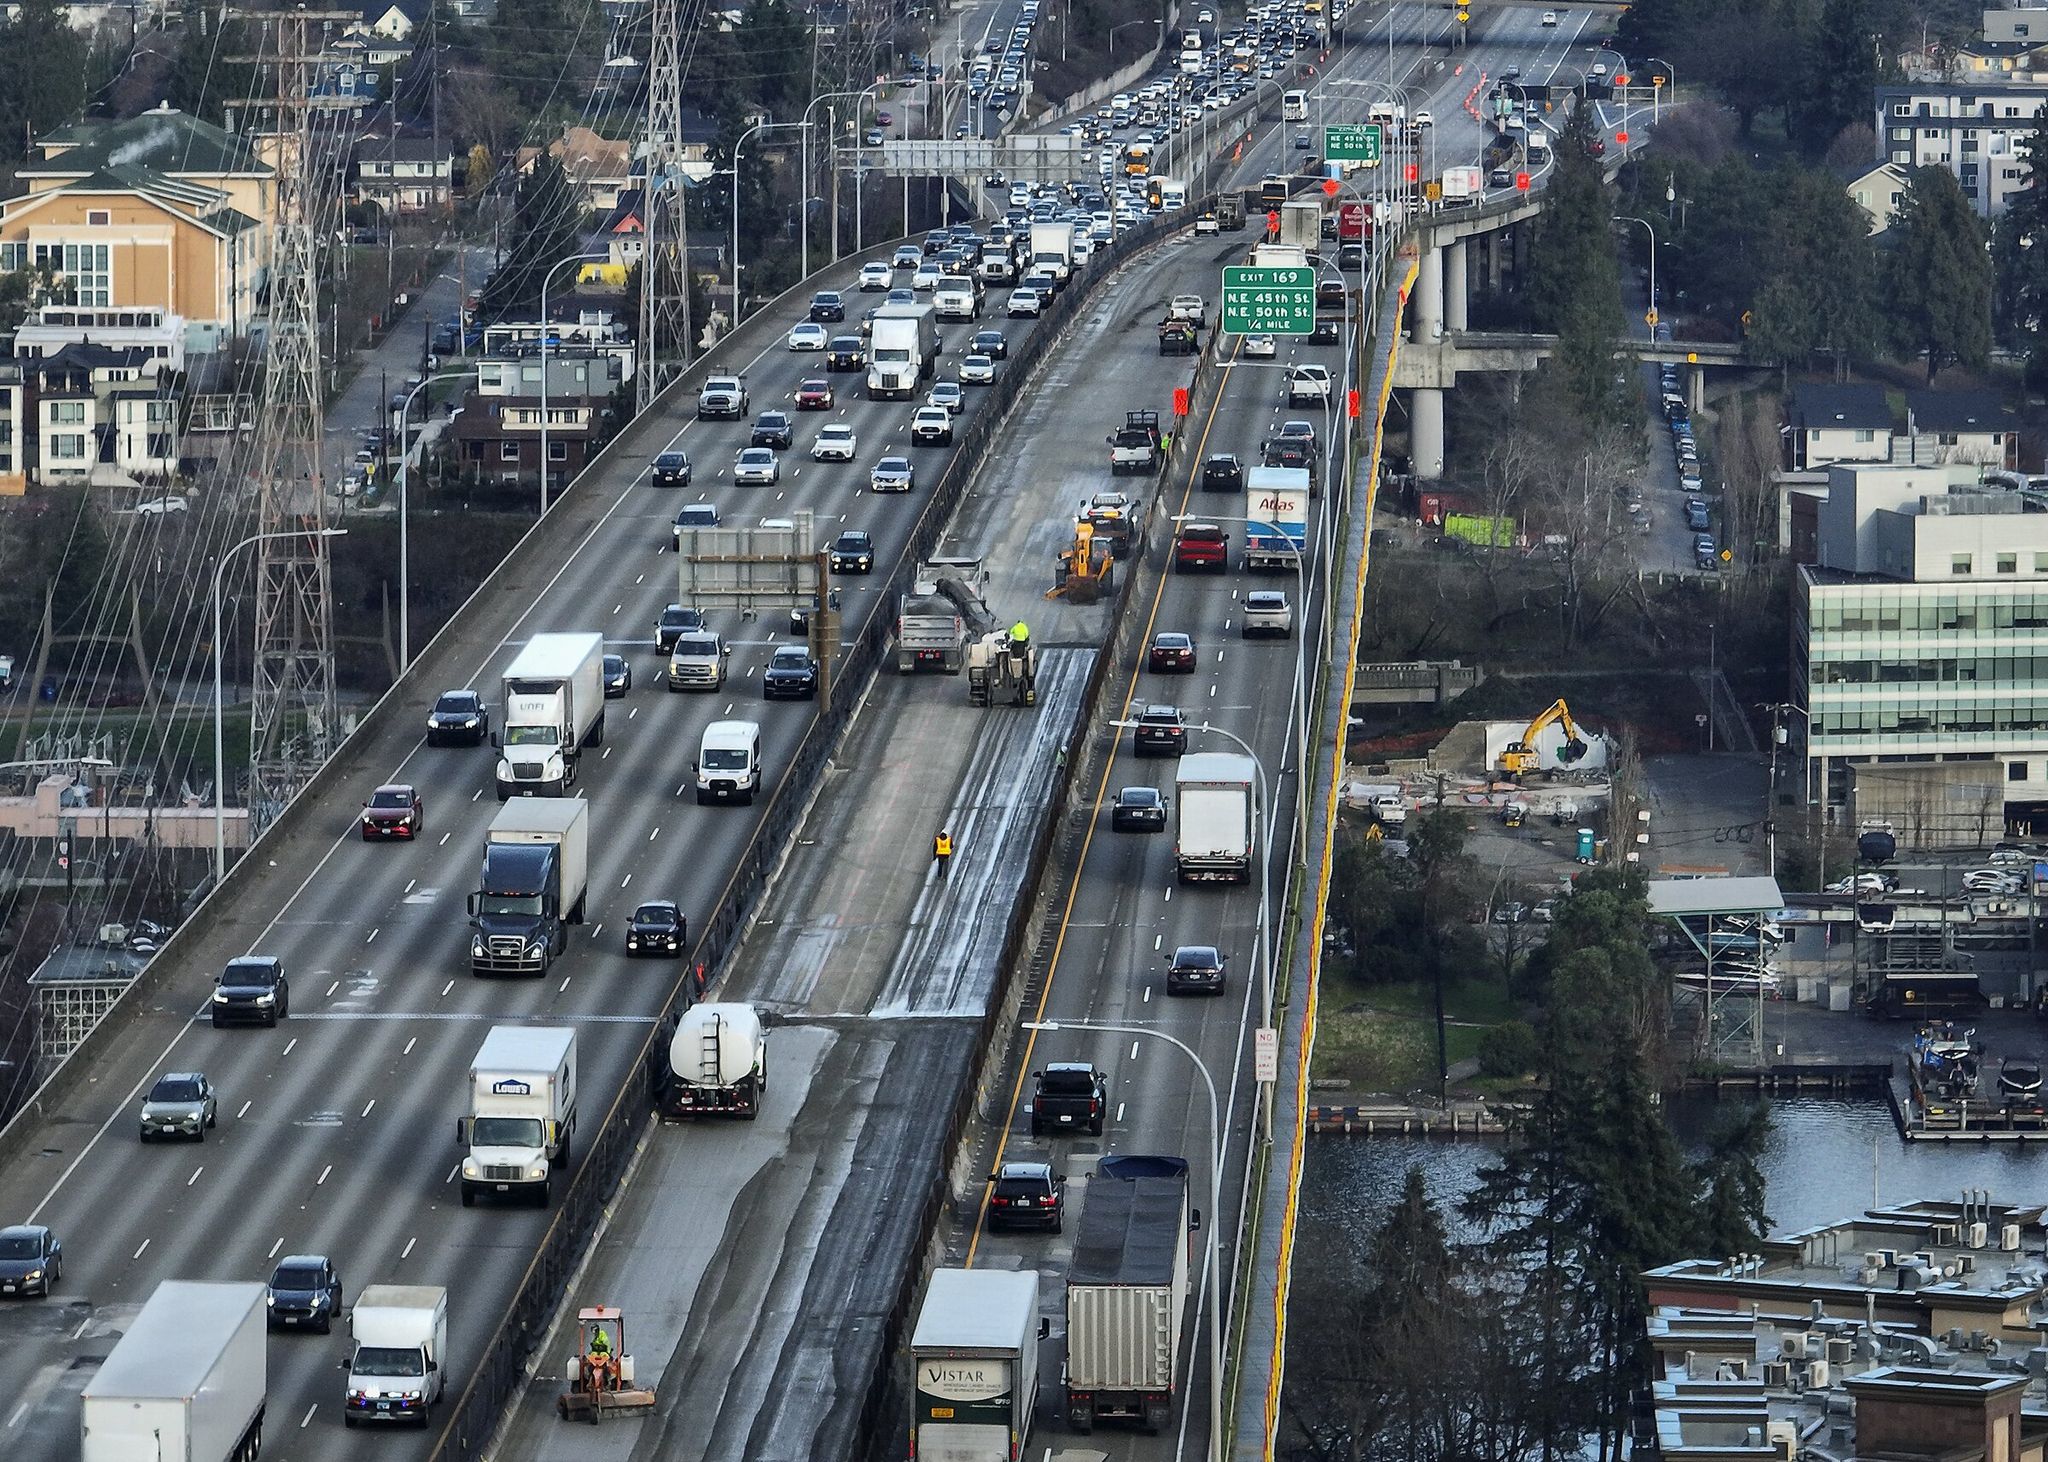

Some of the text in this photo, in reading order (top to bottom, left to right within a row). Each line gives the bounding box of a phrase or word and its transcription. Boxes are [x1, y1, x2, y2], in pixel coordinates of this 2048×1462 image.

[1239, 271, 1298, 283] EXIT 169
[1227, 293, 1310, 304] N.E. 45th St.
[1227, 306, 1311, 317] N.E. 50th St.
[1266, 320, 1291, 329] MILE
[1259, 497, 1295, 511] Atlas
[1260, 1033, 1273, 1041] NO
[495, 1083, 528, 1094] LOWE'S
[928, 1365, 984, 1384] VISTAR
